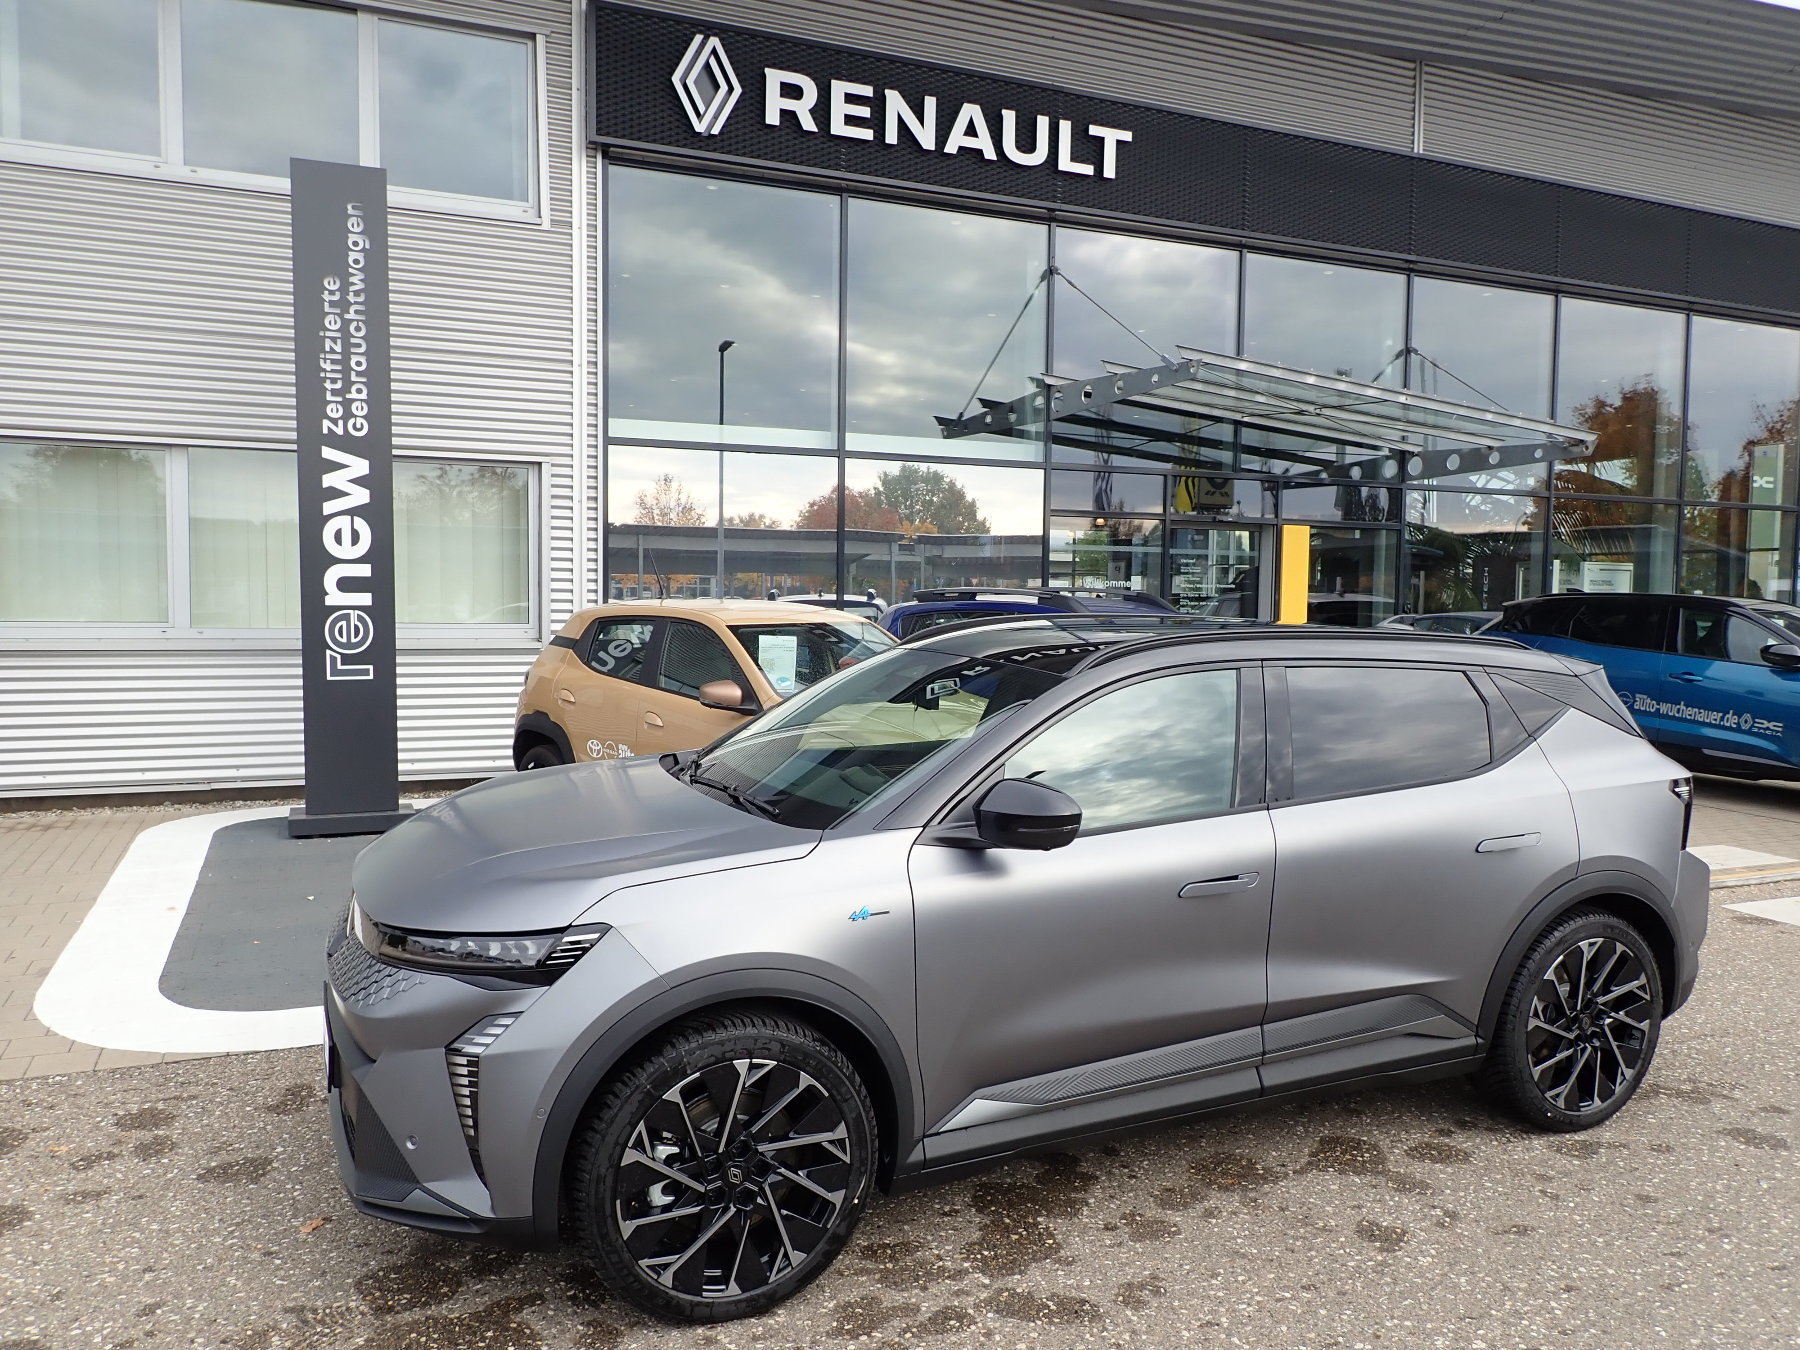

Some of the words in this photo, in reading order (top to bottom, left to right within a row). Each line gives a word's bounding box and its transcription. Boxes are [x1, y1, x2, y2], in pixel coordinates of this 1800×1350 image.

[764, 66, 1133, 180] RENAULT
[319, 273, 344, 436] Zertifizierte
[344, 202, 370, 437] Gebrauchtwagen
[321, 445, 374, 681] renew
[1082, 577, 1132, 588] Willkomme
[1633, 697, 1739, 728] auto-wuchenauer.de
